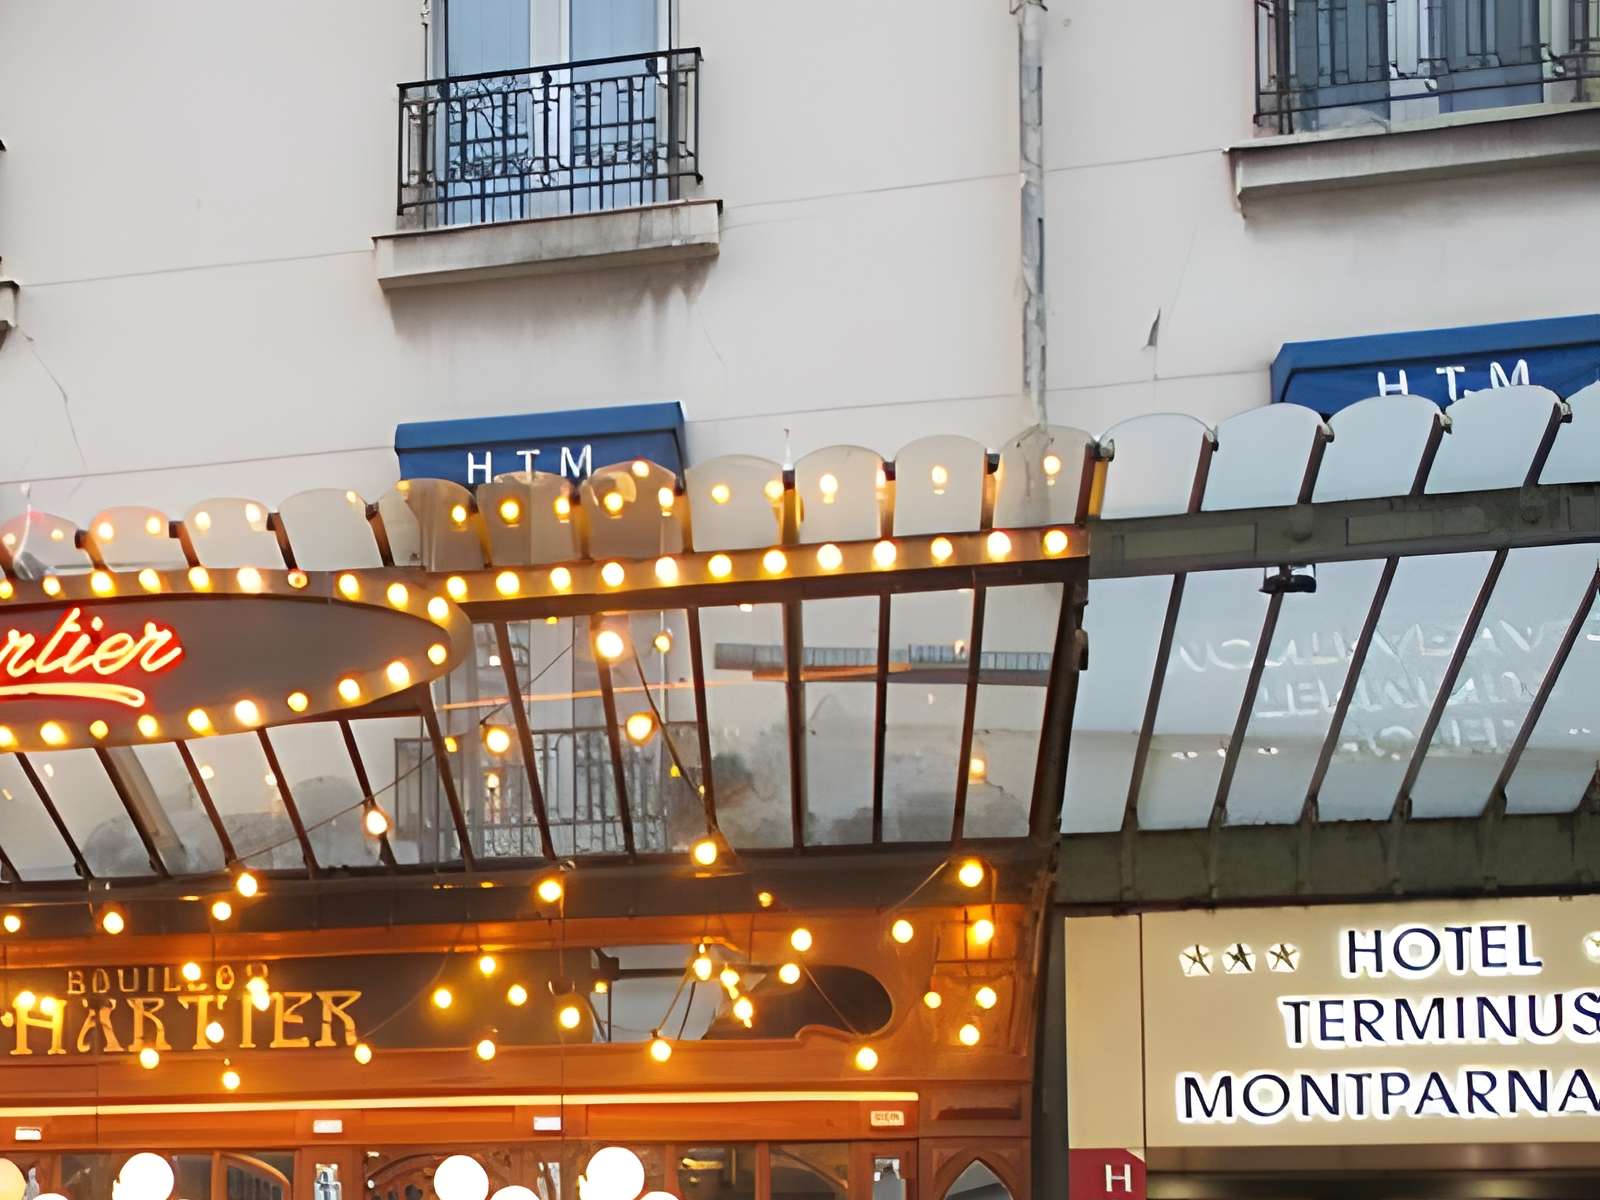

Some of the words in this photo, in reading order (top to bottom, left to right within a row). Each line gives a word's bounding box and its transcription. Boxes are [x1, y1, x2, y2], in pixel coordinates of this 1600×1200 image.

[1347, 924, 1543, 974] HOTEL
[1283, 991, 1600, 1044] TERMINUS
[1105, 1163, 1132, 1192] H
